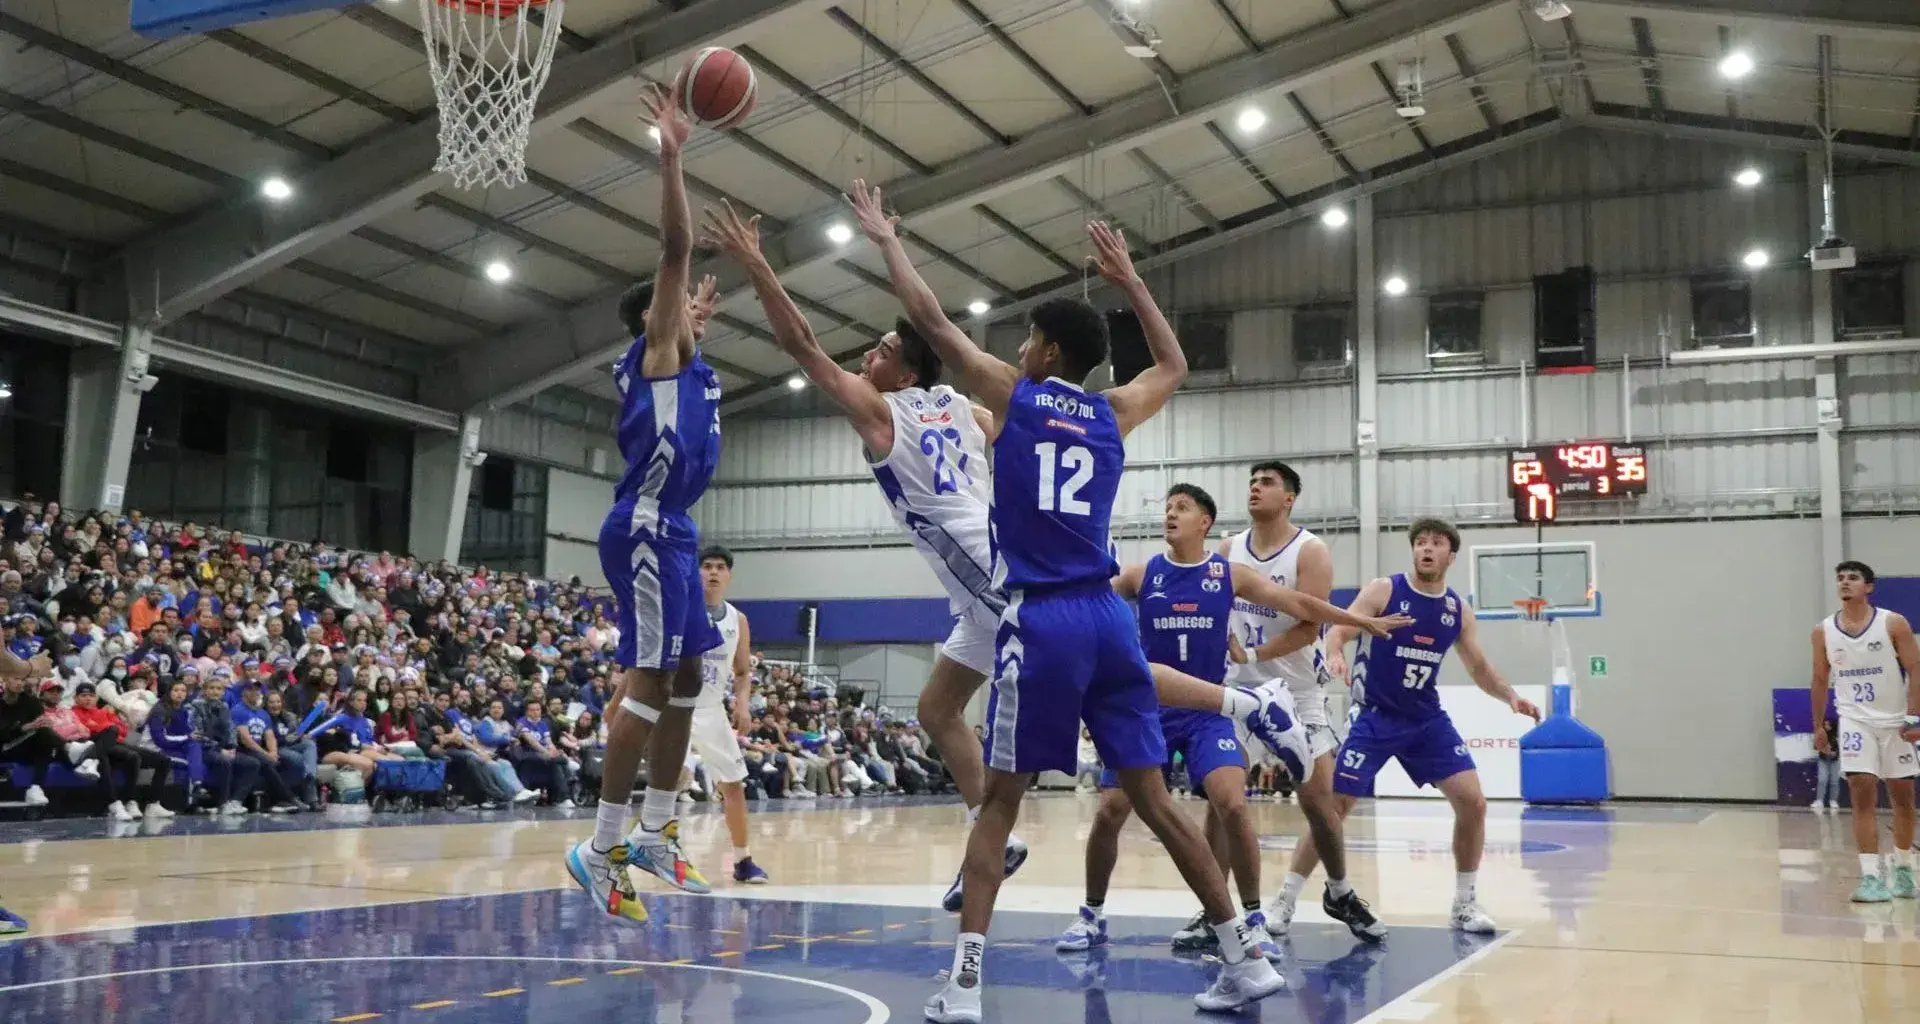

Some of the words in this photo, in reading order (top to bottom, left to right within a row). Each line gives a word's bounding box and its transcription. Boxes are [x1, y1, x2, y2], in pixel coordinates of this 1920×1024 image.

[1034, 393, 1054, 408] TEC
[1078, 403, 1096, 420] TOL
[1558, 445, 1607, 469] 4:50
[1616, 457, 1645, 481] 35
[1034, 441, 1095, 517] 12
[1152, 615, 1215, 630] BORREGOS
[1243, 621, 1265, 648] 21
[1177, 633, 1189, 662] 1
[1402, 663, 1433, 690] 57
[1838, 665, 1884, 678] BORREGOS
[1852, 681, 1876, 703] 23
[1842, 731, 1863, 751] 23
[1342, 749, 1366, 770] 57
